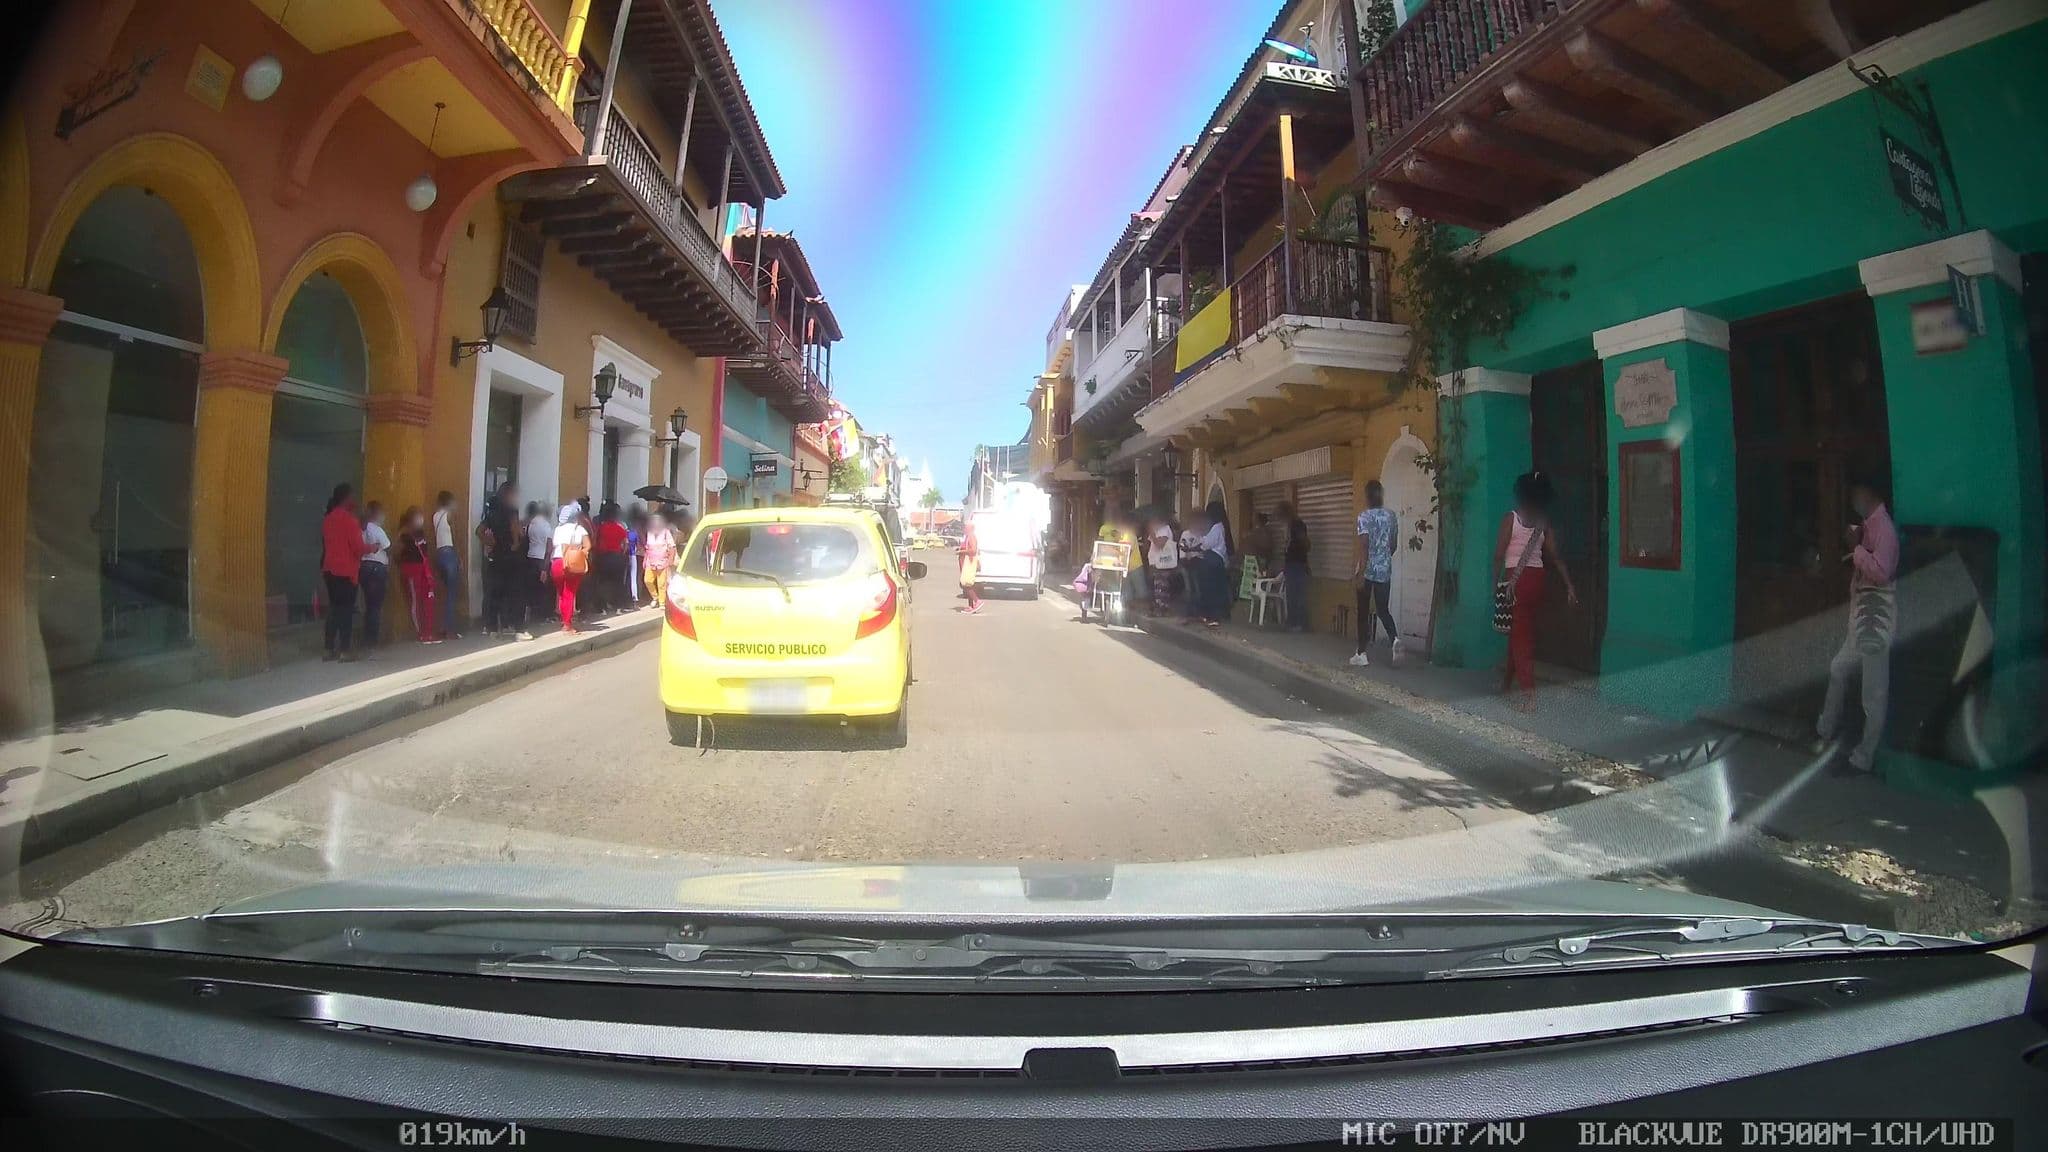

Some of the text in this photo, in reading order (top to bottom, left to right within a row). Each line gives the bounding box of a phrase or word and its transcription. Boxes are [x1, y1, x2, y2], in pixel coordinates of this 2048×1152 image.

[754, 464, 776, 473] Selina
[725, 642, 827, 656] SERVICIO PUBLICO
